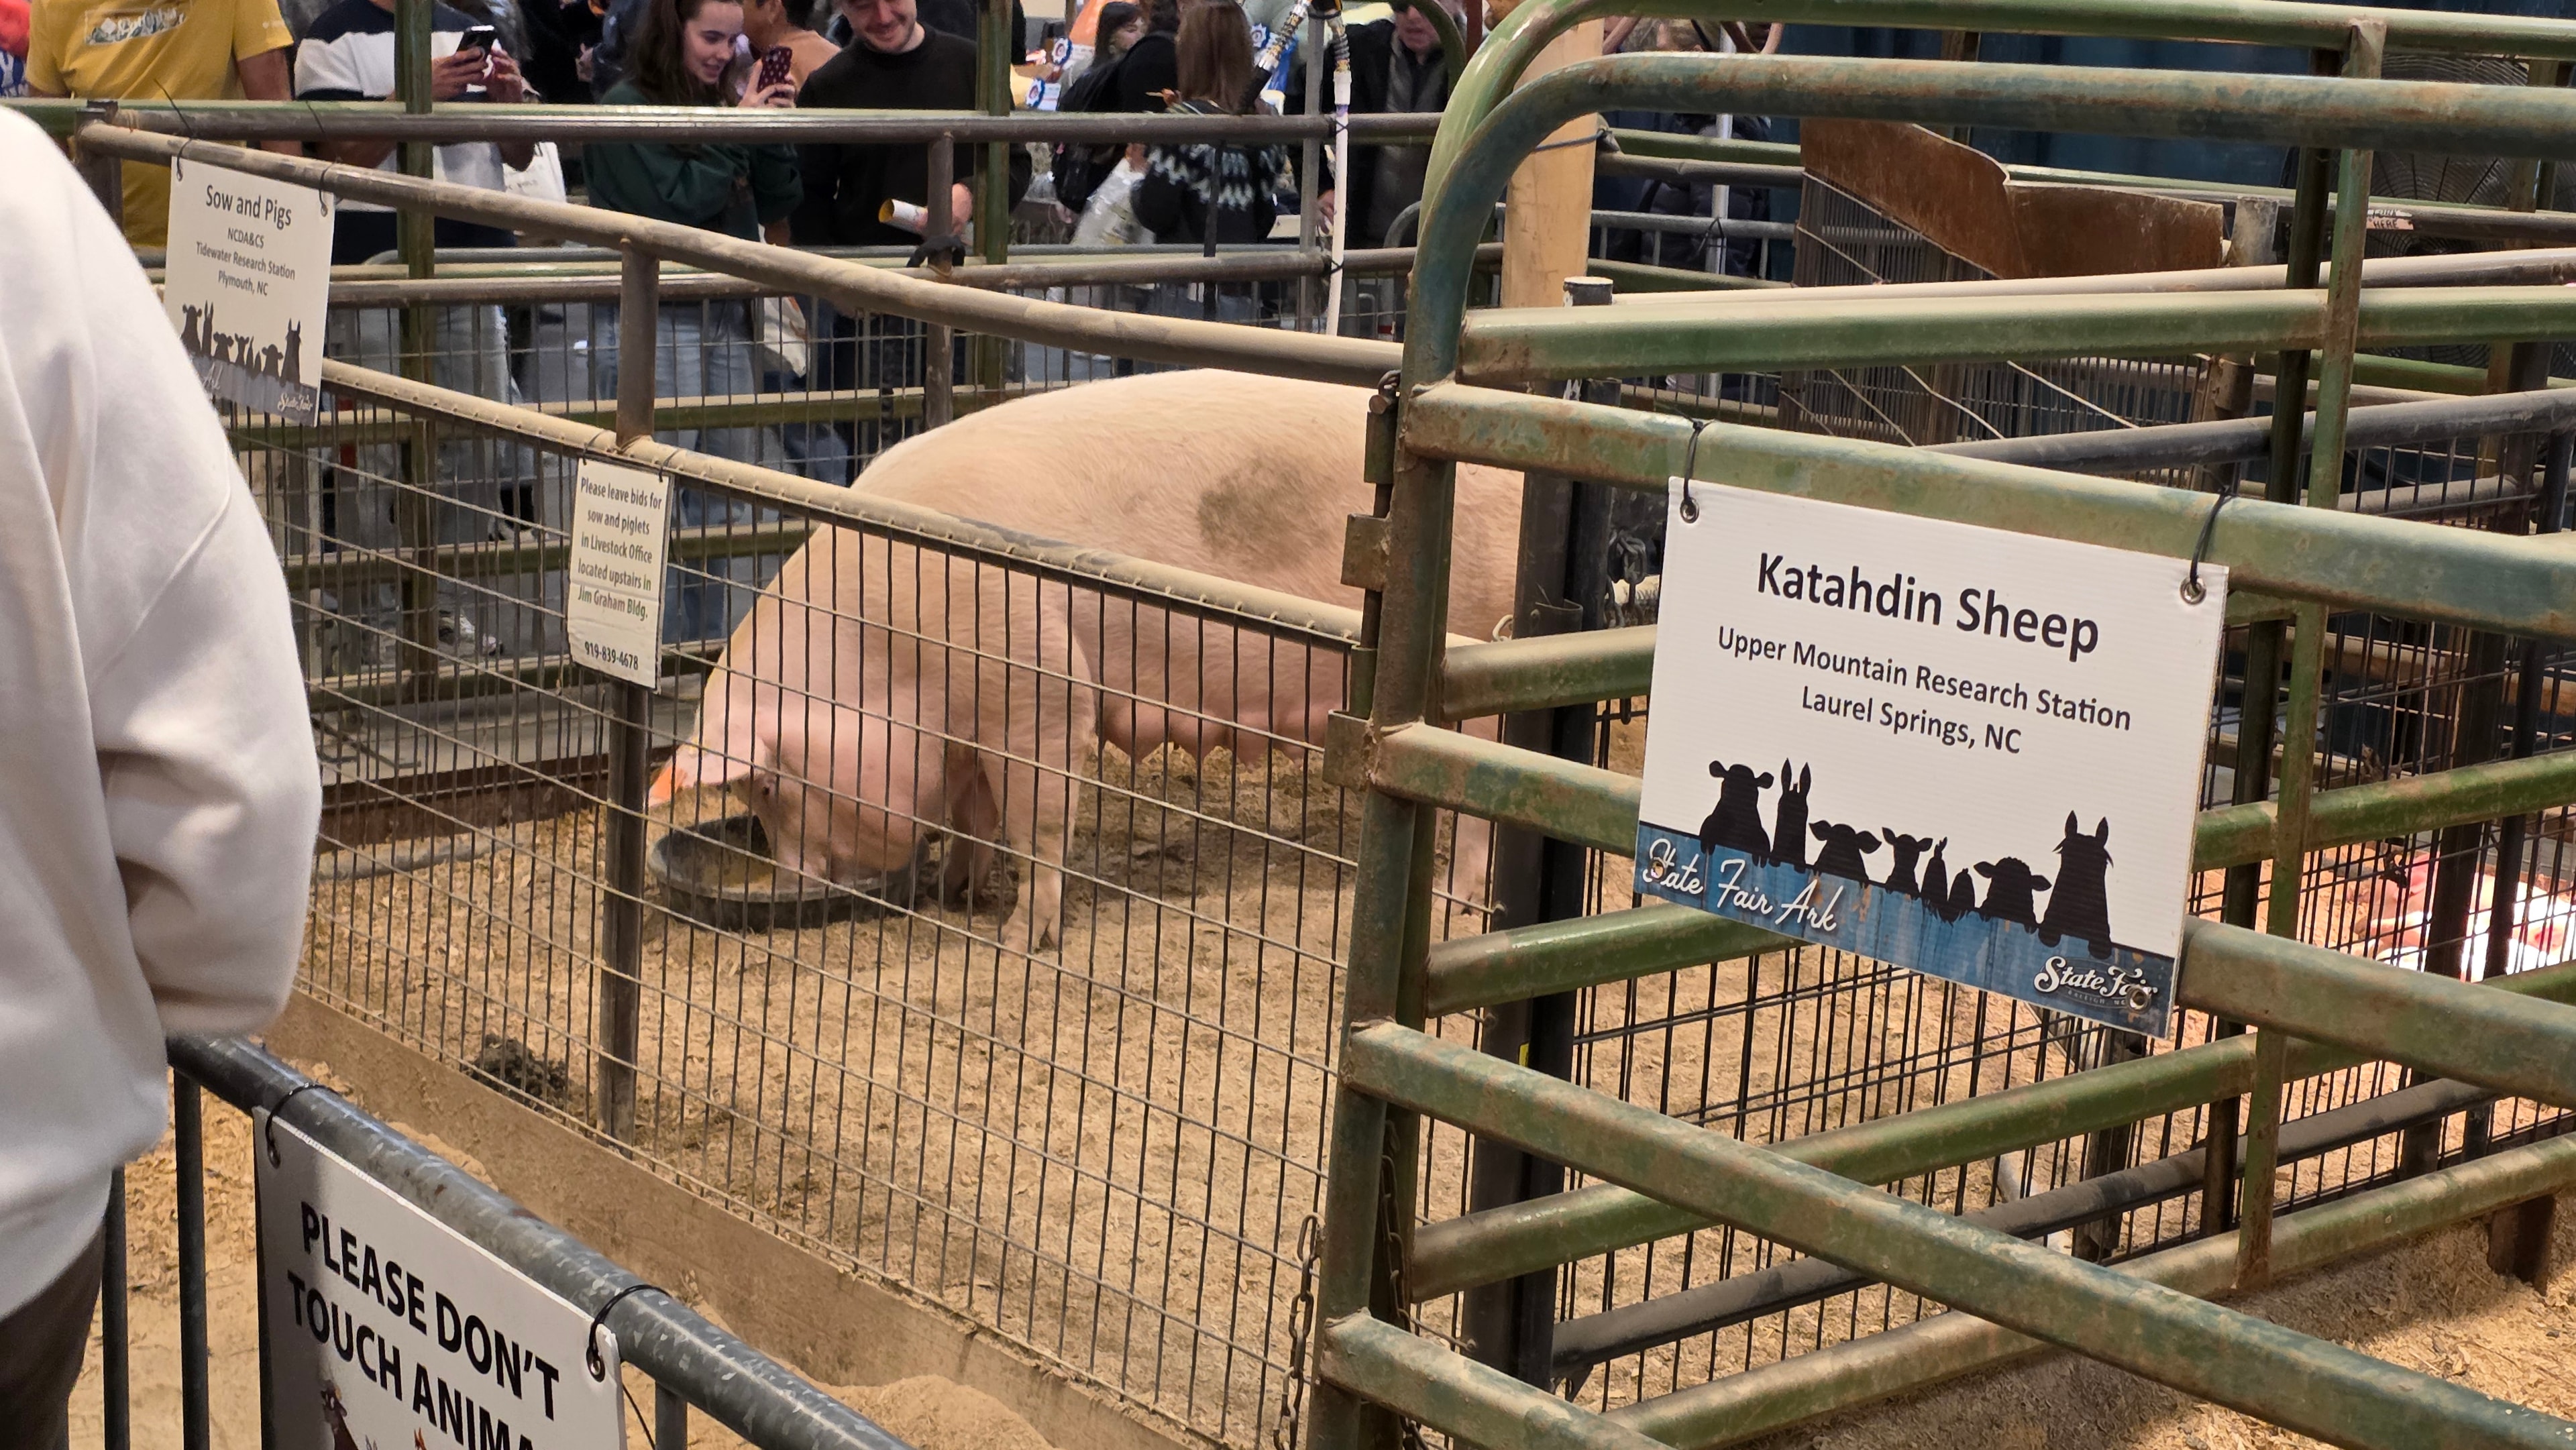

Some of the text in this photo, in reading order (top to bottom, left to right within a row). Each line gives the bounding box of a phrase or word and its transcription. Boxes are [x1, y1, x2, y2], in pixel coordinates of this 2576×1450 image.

[206, 184, 291, 230] Sow and Pigs
[227, 227, 264, 249] NCDA&CS
[196, 241, 295, 280] Tidewater Research Station
[218, 270, 268, 296] Plymouth, NC
[580, 477, 661, 510] Please leave bids for
[588, 510, 650, 536] sow and piglets
[581, 531, 652, 564] in Livestock Office
[578, 557, 651, 592] located upstairs in
[578, 585, 648, 621] Jim Graham Bldg.
[1758, 552, 2099, 662] Katahdin Sheep
[584, 640, 639, 670] 919-839-4678
[1718, 625, 2131, 730] Upper Mountain Research Station
[1802, 685, 2022, 754] Laurel Springs, NC
[1642, 838, 1844, 932] State Fair Ark
[2034, 956, 2158, 997] State Far
[301, 1201, 559, 1421] PLEASE DON'T
[287, 1270, 534, 1450] TOUCH ANIM
